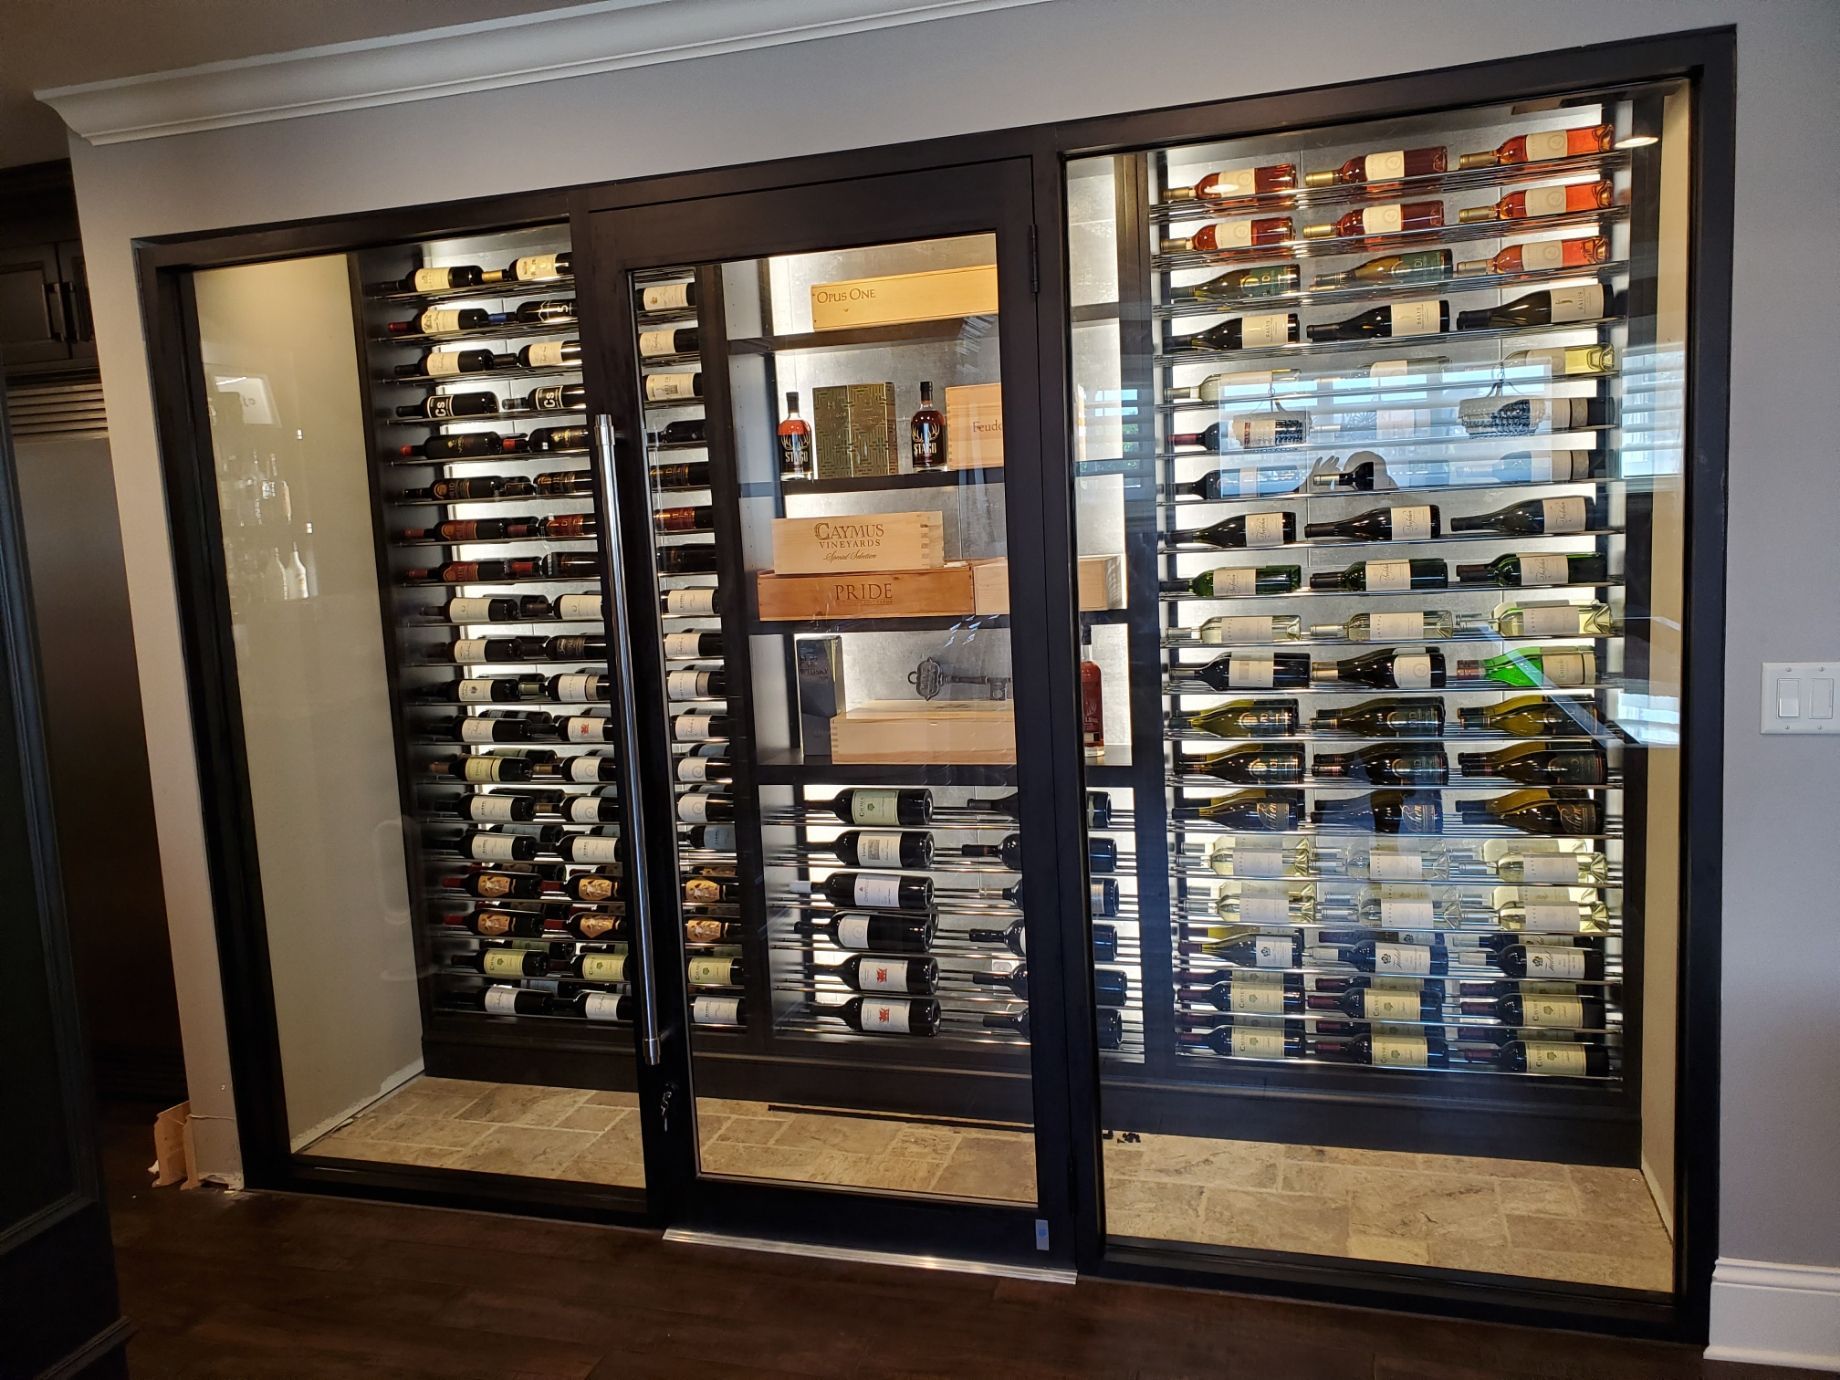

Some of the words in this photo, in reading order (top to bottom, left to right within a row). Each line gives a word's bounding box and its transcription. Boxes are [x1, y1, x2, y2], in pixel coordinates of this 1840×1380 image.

[543, 391, 556, 408] Cs
[435, 401, 446, 417] Cs
[814, 522, 885, 541] CAYMUS
[818, 539, 881, 549] VINEYARDS
[833, 583, 893, 601] PRIDE
